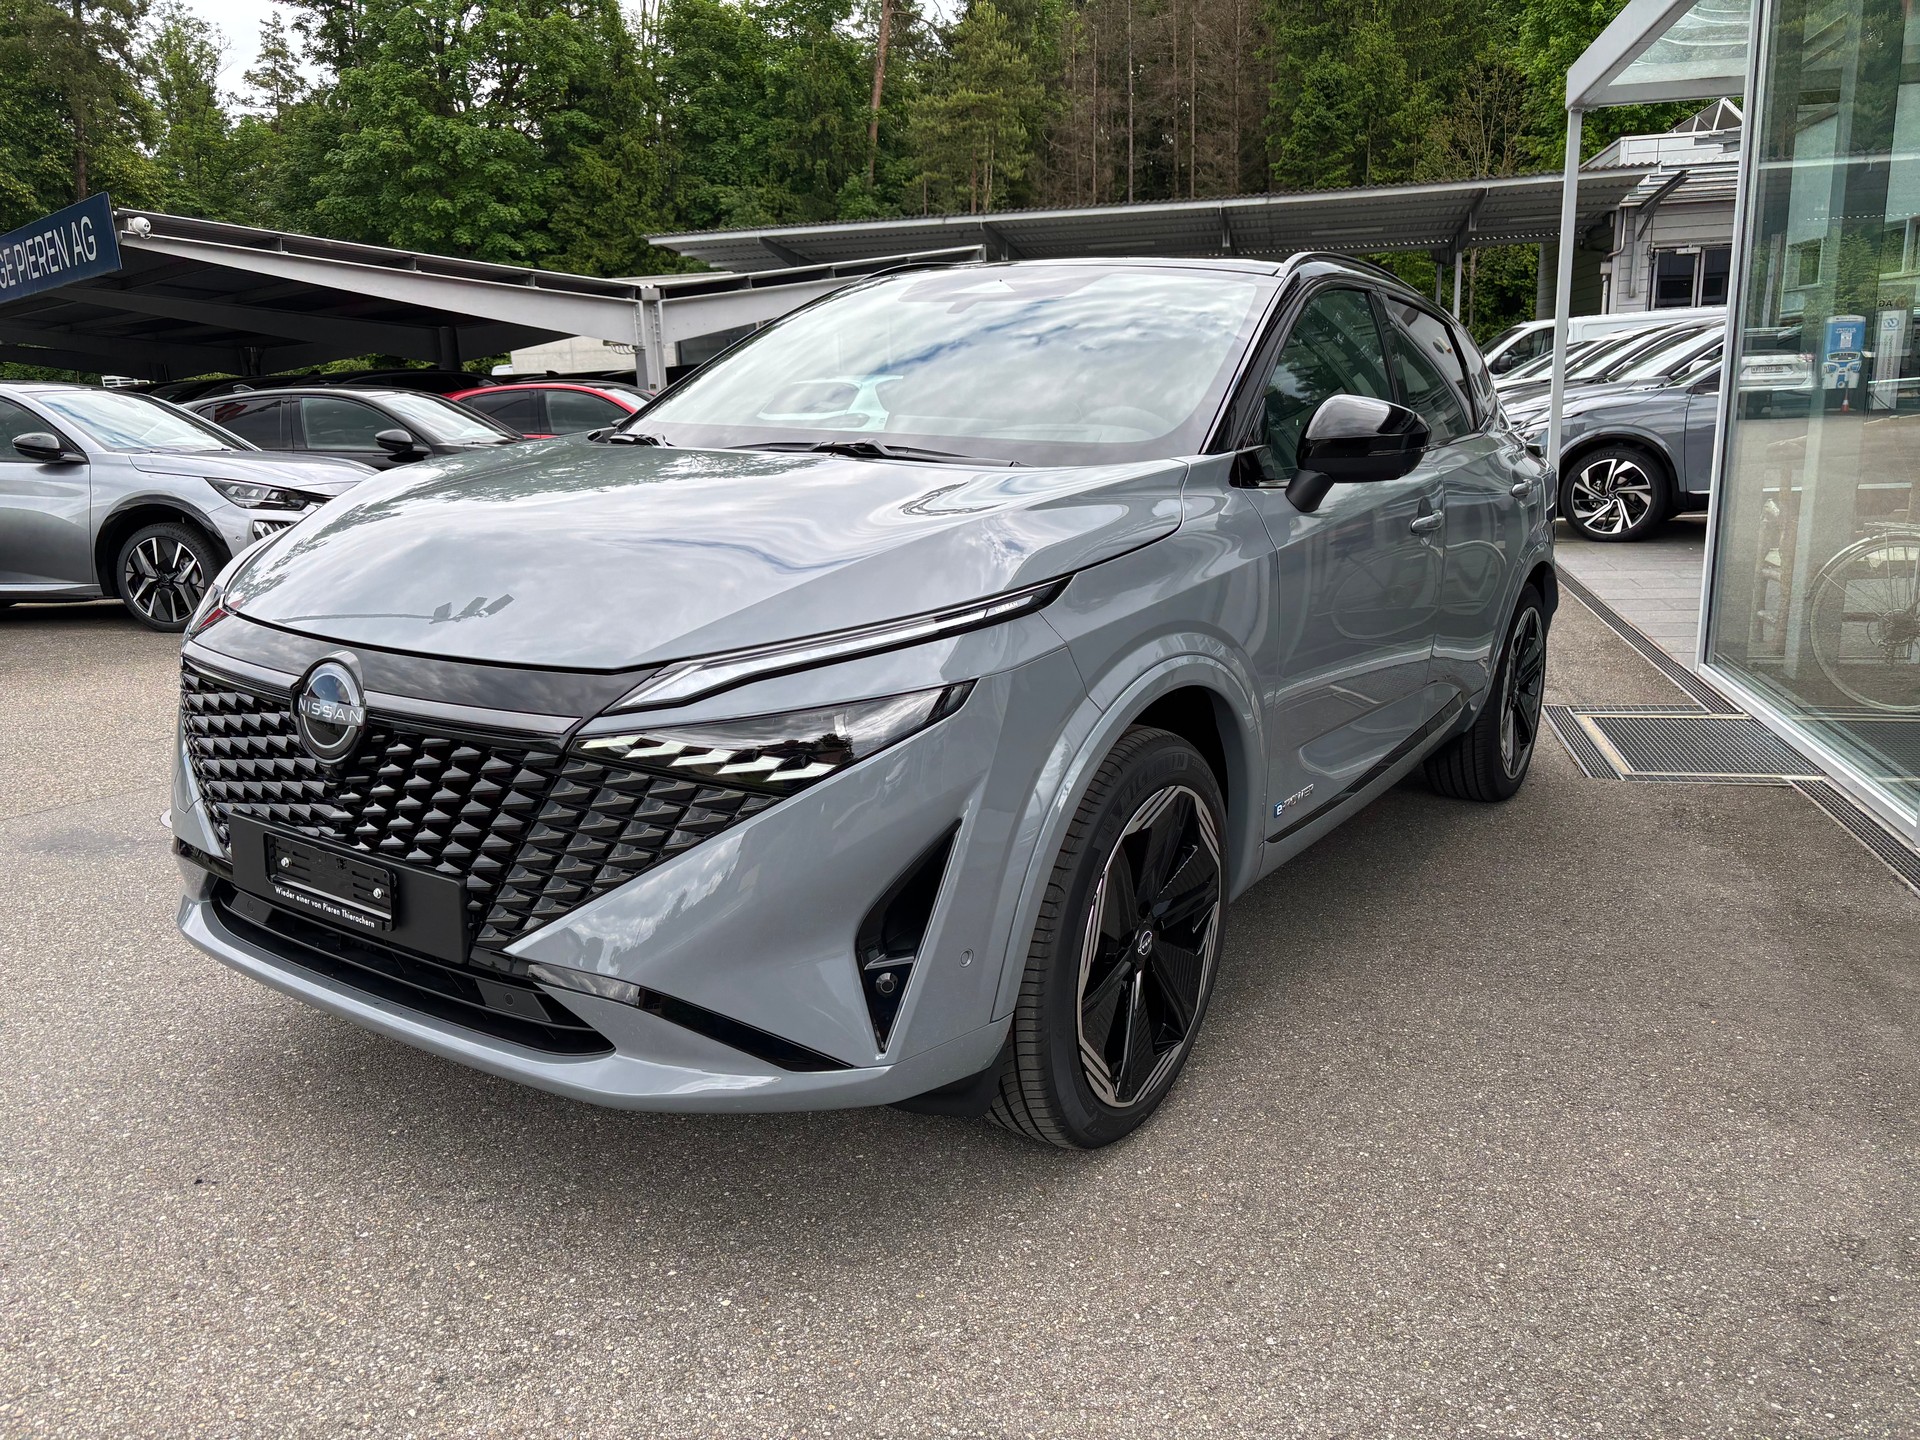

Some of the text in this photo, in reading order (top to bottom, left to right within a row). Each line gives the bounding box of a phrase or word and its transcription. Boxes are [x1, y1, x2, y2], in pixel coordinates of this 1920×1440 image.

[13, 226, 71, 283] PIEREN
[71, 215, 97, 266] AG
[298, 697, 364, 723] NISSAN
[275, 885, 295, 899] Wieder
[296, 894, 310, 905] einer
[311, 900, 322, 909] von
[322, 902, 340, 915] Pieren
